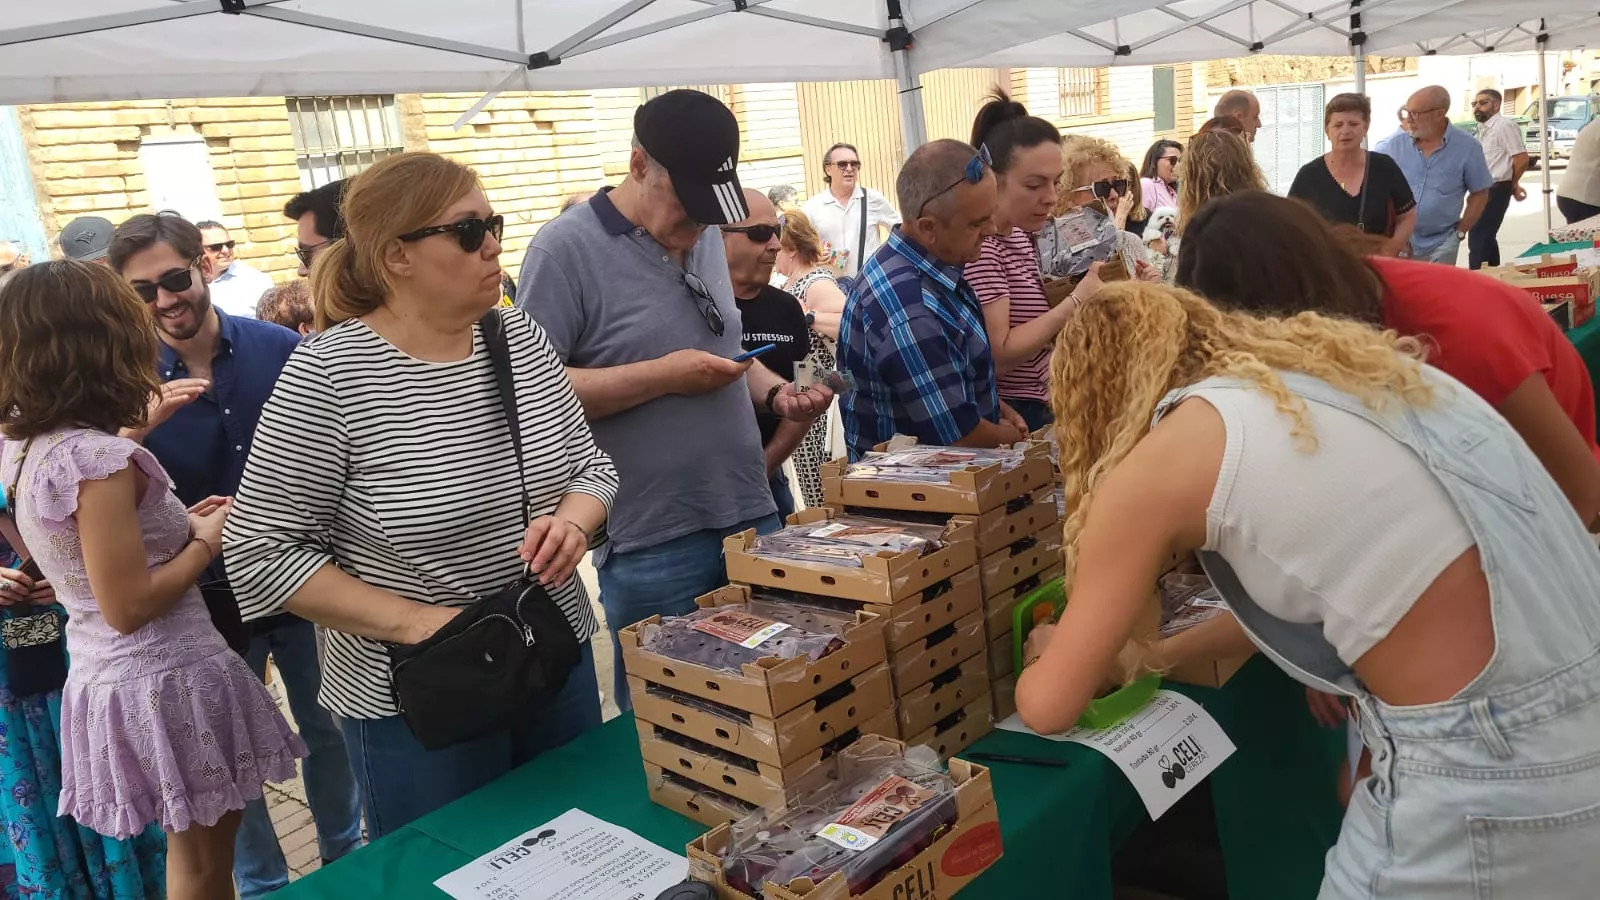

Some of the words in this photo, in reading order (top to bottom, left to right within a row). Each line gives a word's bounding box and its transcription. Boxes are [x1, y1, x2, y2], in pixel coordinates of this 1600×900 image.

[1532, 291, 1574, 301] Bueso
[752, 333, 794, 343] STRESSED?
[1113, 738, 1131, 753] Natural
[1173, 735, 1201, 766] CELI
[1129, 753, 1149, 770] Tostado
[1146, 747, 1155, 756] 80
[864, 806, 903, 829] CELI
[593, 836, 618, 852] Natural
[490, 846, 531, 870] CELI
[600, 850, 646, 877] MERMELADA
[638, 857, 664, 875] CEREZA
[644, 860, 671, 878] CEREZA
[893, 861, 935, 900] CELI
